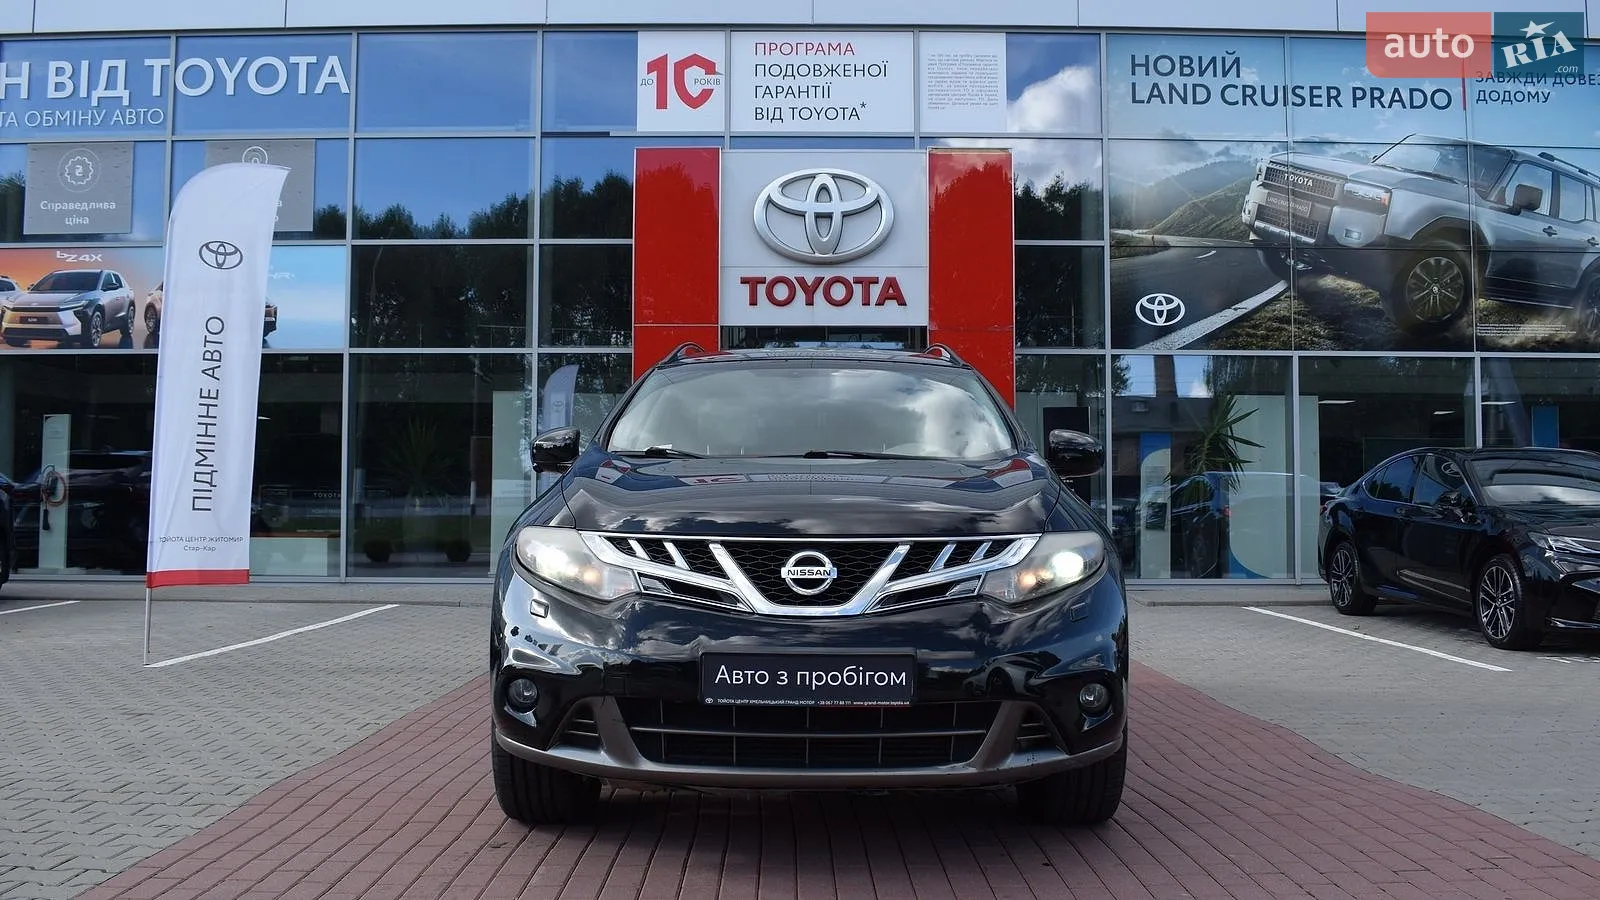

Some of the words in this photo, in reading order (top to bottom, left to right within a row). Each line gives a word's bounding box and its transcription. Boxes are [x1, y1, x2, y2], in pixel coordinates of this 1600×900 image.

[754, 42, 856, 56] ПРОГРАМА
[754, 60, 889, 80] ПОДОВЖЕНОЇ
[1130, 50, 1241, 78] НОВИЙ
[47, 59, 130, 106] ВІД
[144, 55, 350, 97] TOYOTA
[640, 78, 654, 86] ДО
[694, 78, 721, 86] РОКІВ
[1475, 70, 1547, 87] ЗАВЖДИ
[754, 81, 833, 99] ГАРАНТІЇ
[1131, 82, 1212, 106] LAND
[1220, 83, 1343, 108] CRUISER
[1351, 86, 1453, 111] PRADO
[1475, 89, 1551, 105] ДОДОМУ
[25, 109, 106, 127] ОБМІНУ
[111, 108, 164, 126] АВТО
[754, 107, 784, 123] ВІД
[1284, 173, 1313, 187] TOYOTA
[40, 200, 117, 212] Справедлива
[65, 215, 90, 226] ціна
[740, 275, 908, 307] TOYOTA
[201, 315, 225, 381] АВТО
[192, 387, 219, 511] ПІДМІННЕ
[714, 664, 770, 685] Авто
[776, 671, 788, 686] з
[796, 665, 907, 690] пробігом
